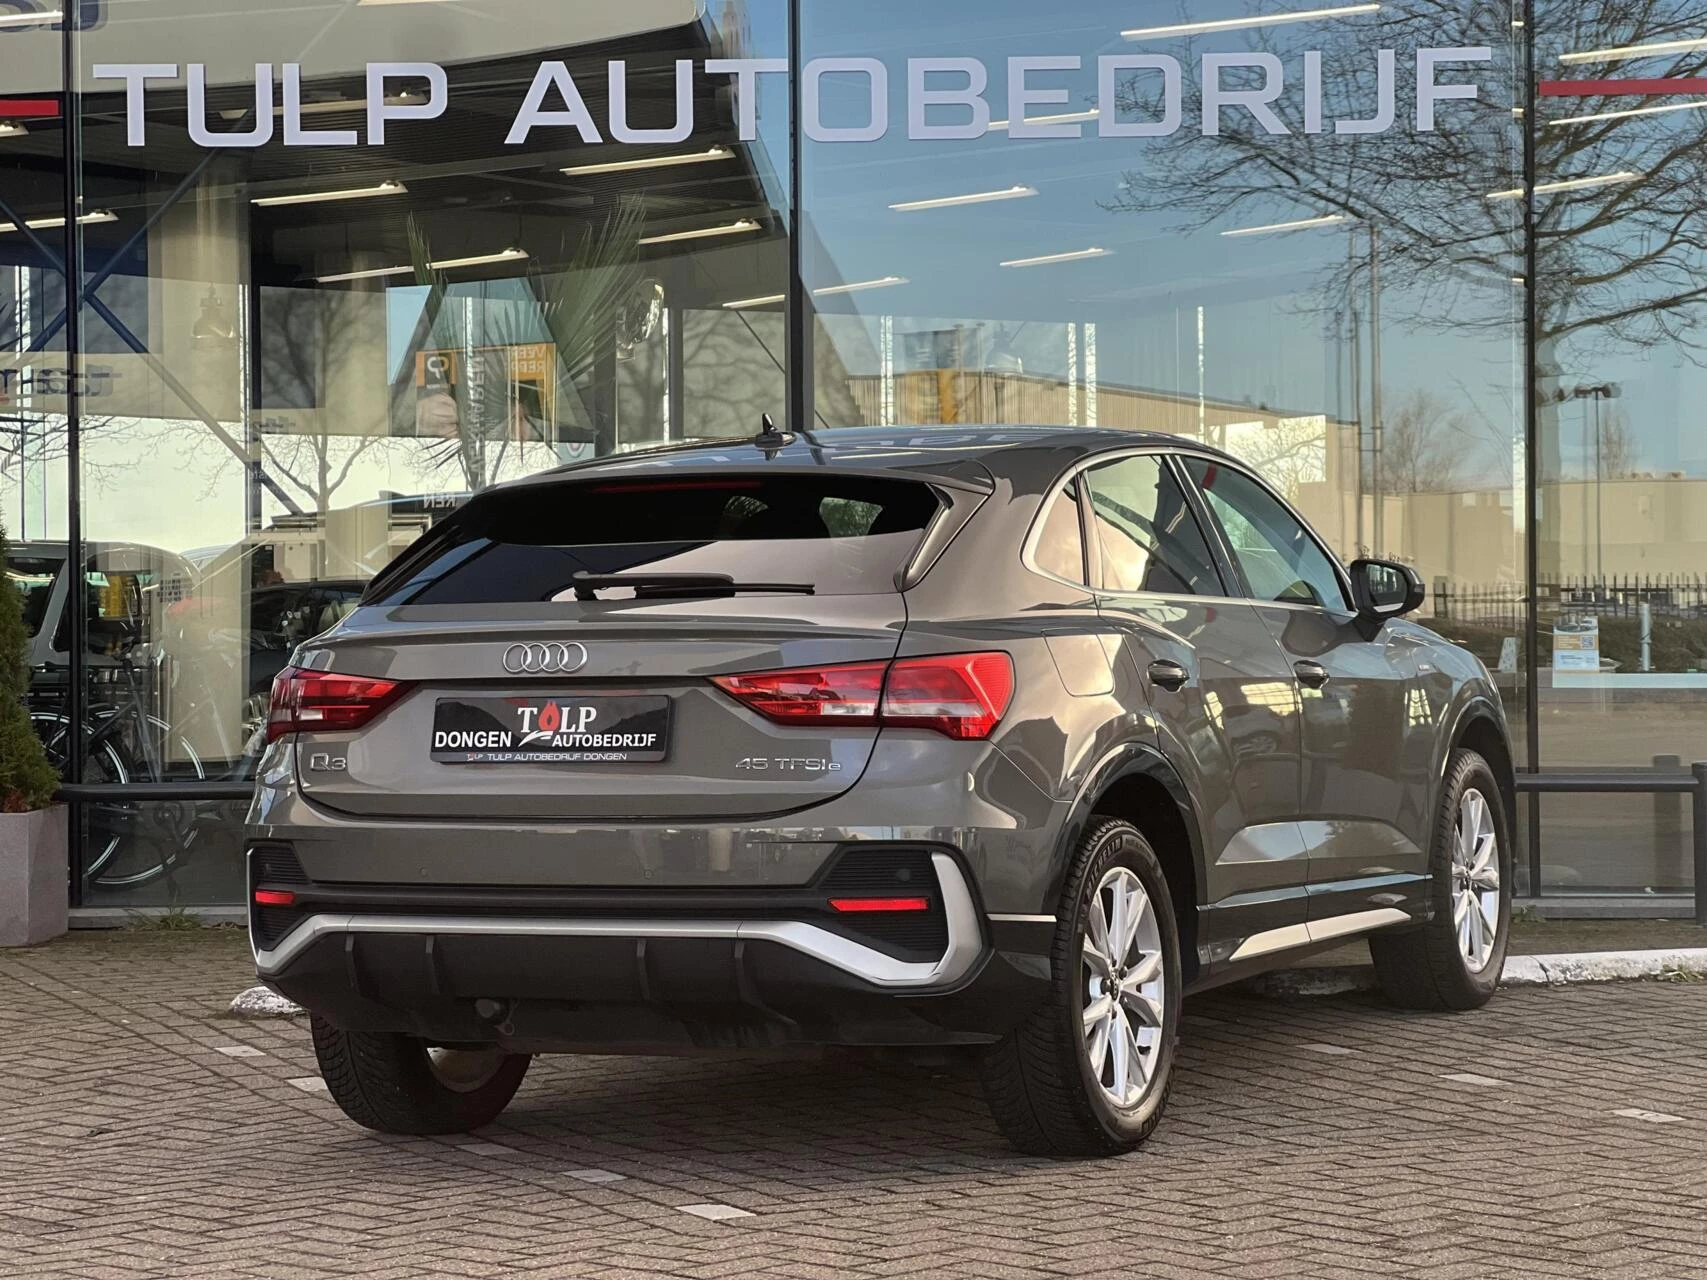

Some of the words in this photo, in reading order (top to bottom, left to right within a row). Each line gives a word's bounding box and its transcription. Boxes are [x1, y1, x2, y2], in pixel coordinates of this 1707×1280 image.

[93, 60, 448, 148] TULP
[503, 46, 1492, 145] AUTOBEDRIJF
[434, 730, 512, 748] DONGEN
[551, 733, 657, 748] AUTOBEDRIJF
[310, 752, 346, 771] Q3
[487, 752, 513, 761] TULP
[513, 752, 582, 761] AUTOBEDRIJF
[583, 752, 628, 761] DONGEN
[735, 757, 769, 770] 45
